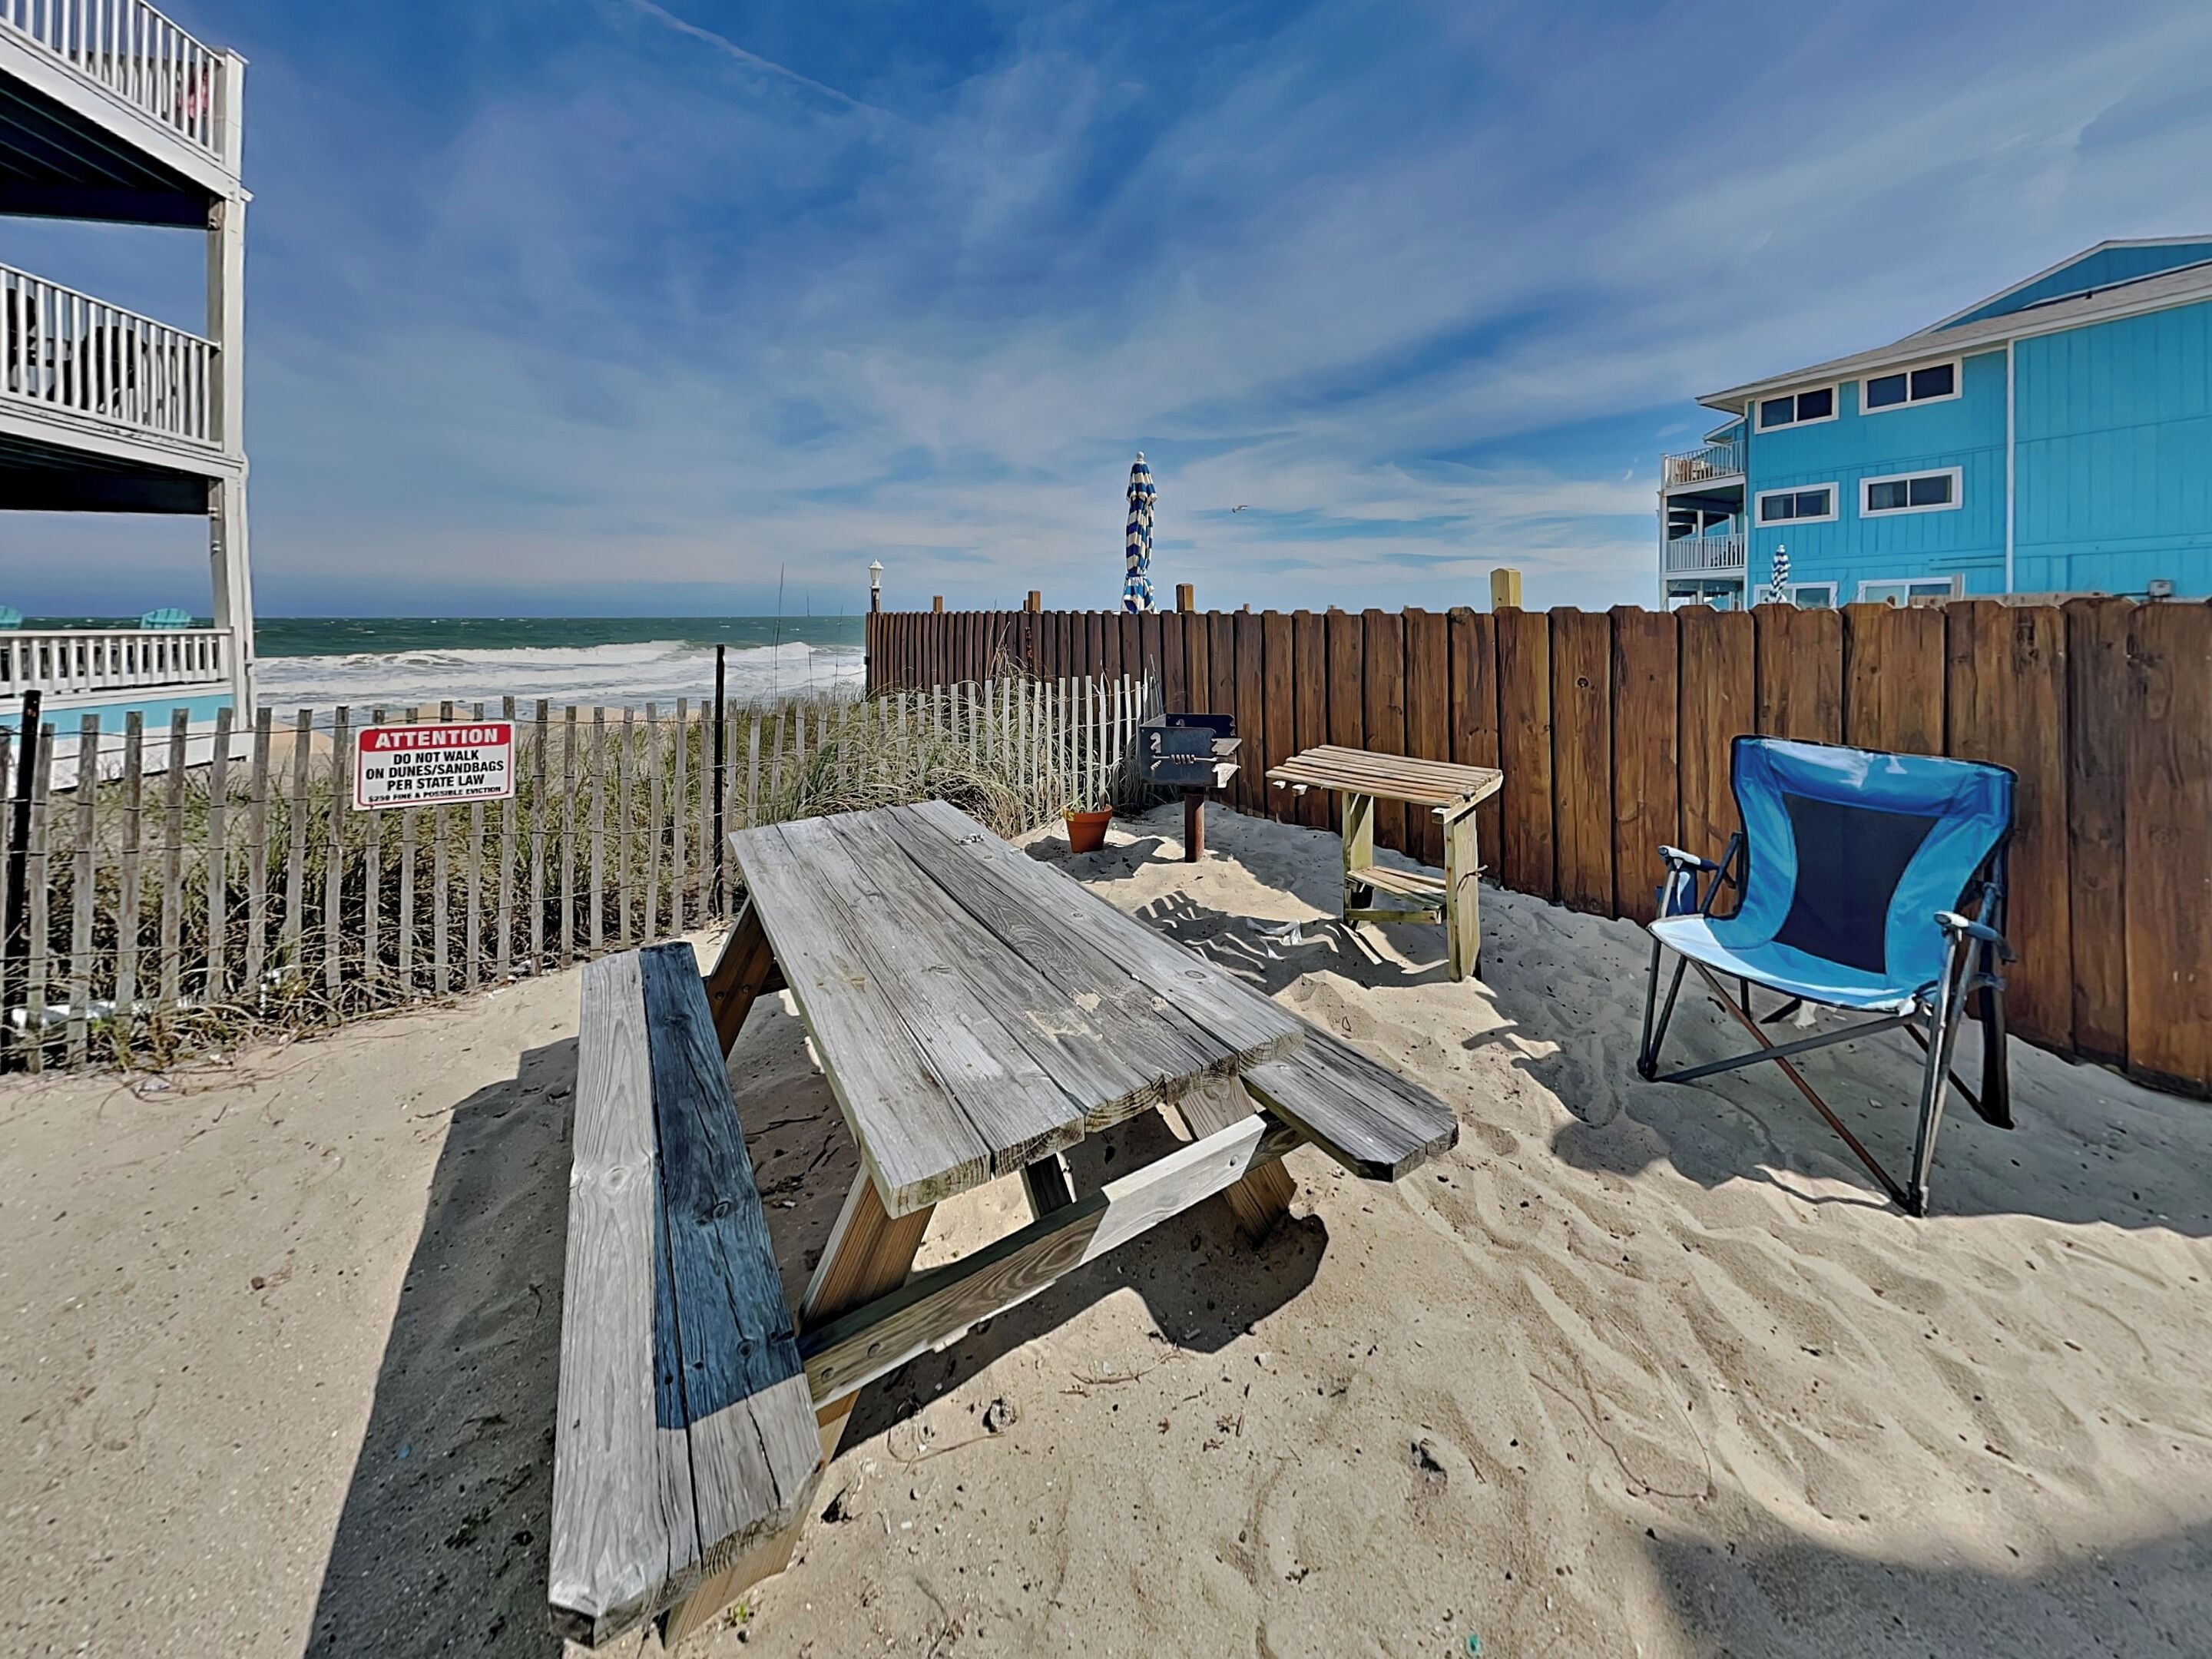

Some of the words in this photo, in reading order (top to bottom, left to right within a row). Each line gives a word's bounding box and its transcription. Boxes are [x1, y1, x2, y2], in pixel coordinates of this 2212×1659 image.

[375, 728, 498, 748] ATTENTION
[393, 753, 410, 764] DO
[416, 752, 440, 763] NOT
[443, 750, 478, 761] WALK
[366, 768, 383, 780] ON
[389, 760, 504, 778] DUNES/SANDBAGS
[387, 780, 412, 791] PER
[417, 777, 454, 789] STATE
[459, 774, 485, 786] LAW
[423, 789, 462, 797] POSSIBLE
